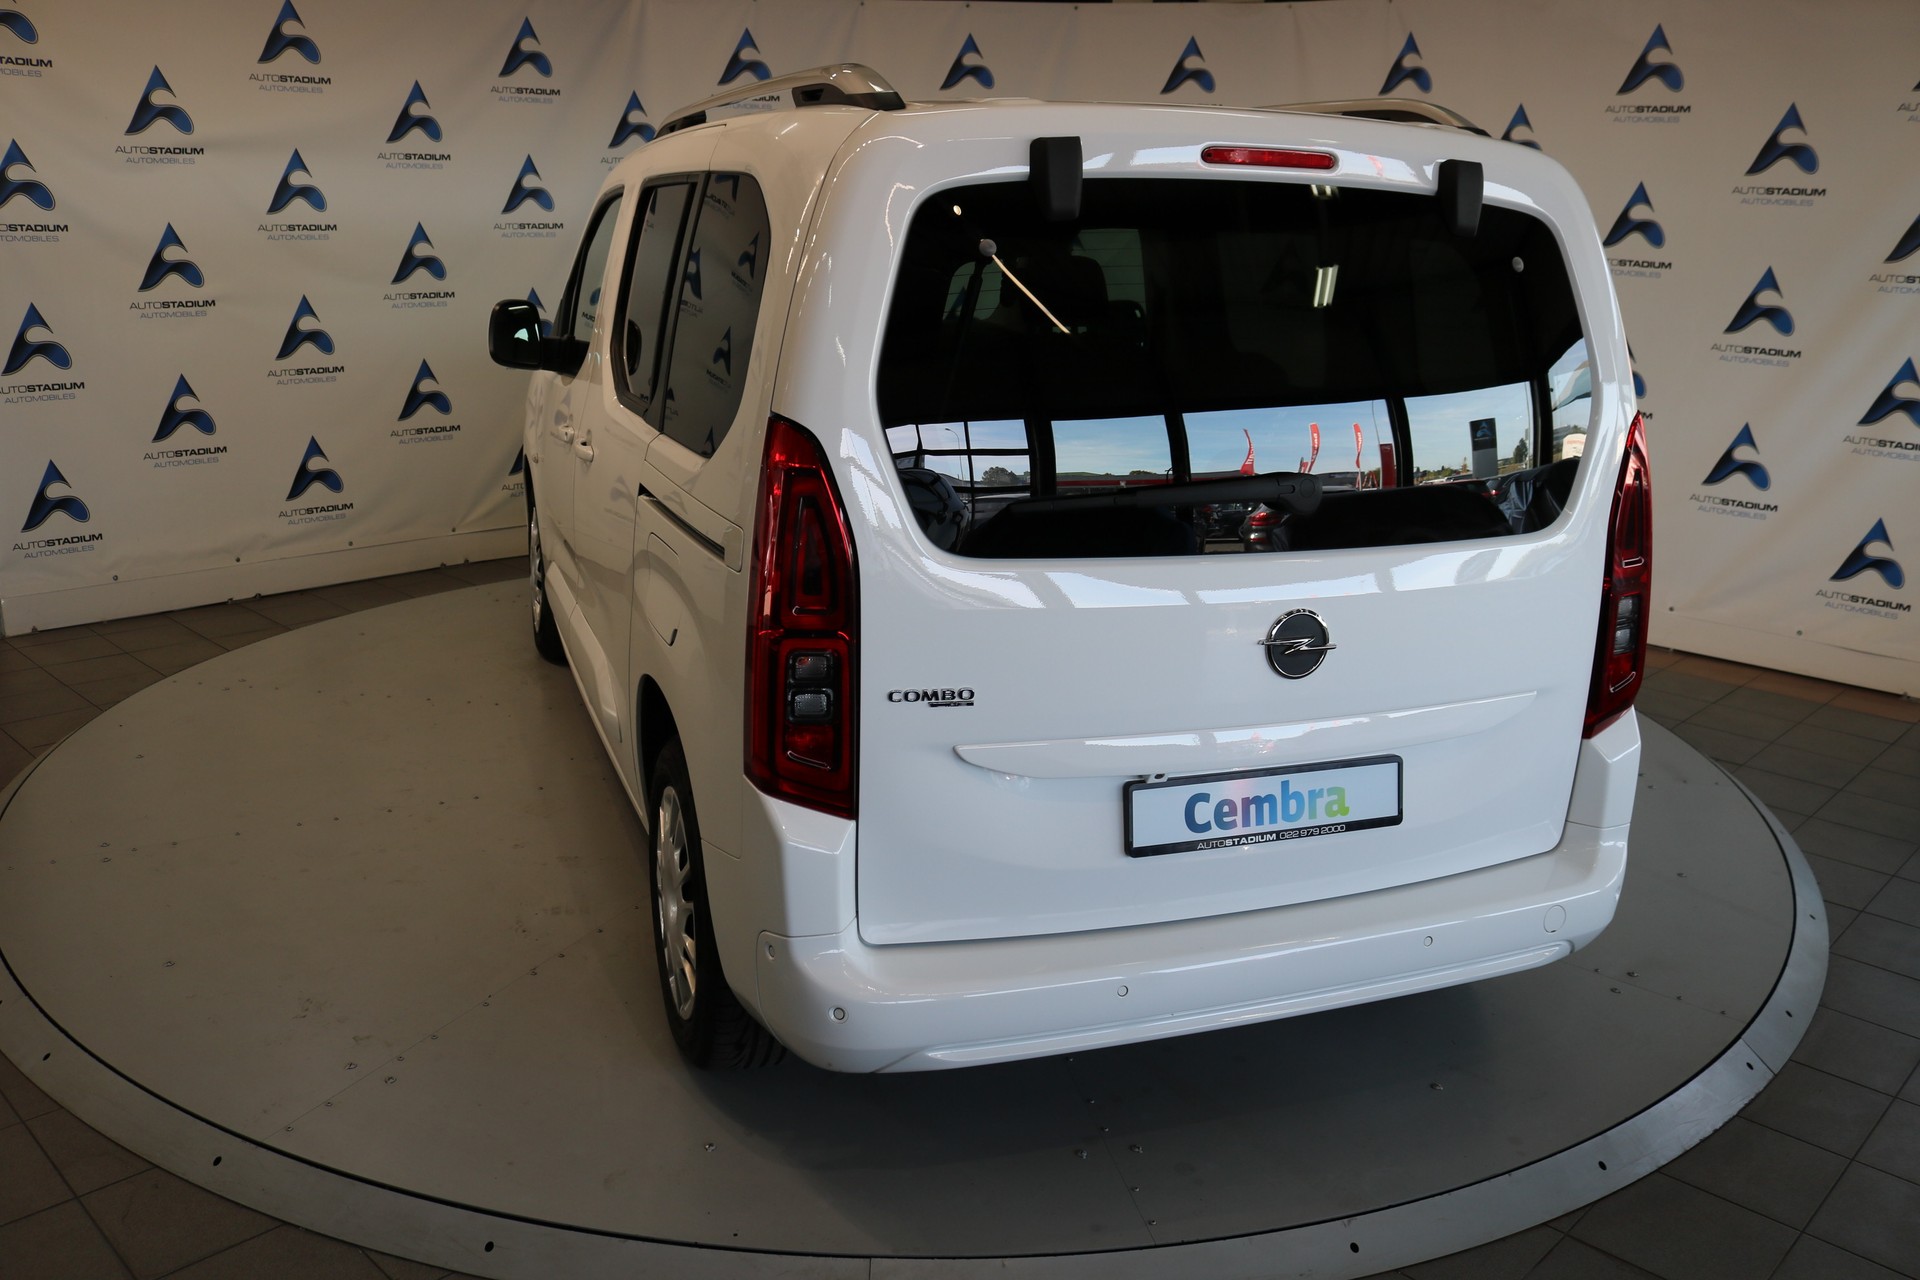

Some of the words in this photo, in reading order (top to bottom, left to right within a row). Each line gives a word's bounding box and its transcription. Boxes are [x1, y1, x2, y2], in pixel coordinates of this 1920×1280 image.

[0, 68, 42, 77] OBILES
[249, 74, 331, 85] AUTOSTADIUM
[258, 84, 323, 94] AUTOMOBILES
[490, 85, 561, 97] AUTOSTADIUM
[498, 95, 554, 104] AUTOMOBILES
[1605, 104, 1691, 113] AUTOSTADIUM
[115, 145, 204, 155] AUTOSTADIUM
[125, 156, 195, 165] AUTOMOBILES
[377, 152, 451, 162] AUTOSTADIUM
[385, 161, 444, 170] AUTOMOBILES
[1732, 186, 1826, 197] AUTOSTADIUM
[1740, 197, 1814, 207] AUTOMOBILES
[257, 223, 337, 232] AUTOSTADIUM
[493, 222, 564, 231] AUTOSTADIUM
[267, 233, 329, 241] AUTOMOBILES
[501, 230, 556, 238] AUTOMOBILES
[383, 291, 455, 301] AUTOSTADIUM
[129, 299, 216, 310] AUTOSTADIUM
[391, 300, 448, 309] AUTOMOBILES
[140, 310, 207, 319] AUTOMOBILES
[1711, 343, 1802, 359] AUTOSTADIUM
[1719, 355, 1790, 368] AUTOMOBILES
[267, 365, 345, 378] AUTOSTADIUM
[276, 375, 337, 386] AUTOMOBILES
[0, 382, 85, 394] UTOSTADIUM
[4, 393, 76, 404] AUTOMOBILES
[390, 424, 461, 437] AUTOSTADIUM
[398, 434, 454, 445] AUTOMOBILES
[1843, 435, 1920, 451] AUTOSTADI
[143, 446, 228, 461] AUTOSTADIUM
[153, 456, 219, 469] AUTOMOBILES
[1689, 494, 1778, 512] AUTOSTADIUM
[278, 503, 354, 518] AUTOSTADIUM
[1697, 504, 1767, 520] AUTOMOBILES
[287, 513, 346, 526] AUTOMOBILES
[12, 533, 103, 552] AUTOSTADIUM
[23, 544, 95, 559] AUTOMOBILES
[1816, 589, 1911, 612] AUTOSTADIUM
[1824, 601, 1898, 620] AUTOMOBILES
[887, 687, 975, 702] COMBO
[1184, 780, 1350, 834] Cembra
[1196, 832, 1277, 850] AUTOSTADIUM
[1279, 830, 1299, 840] 022
[1300, 826, 1320, 838] 979
[1320, 824, 1346, 835] 2000
